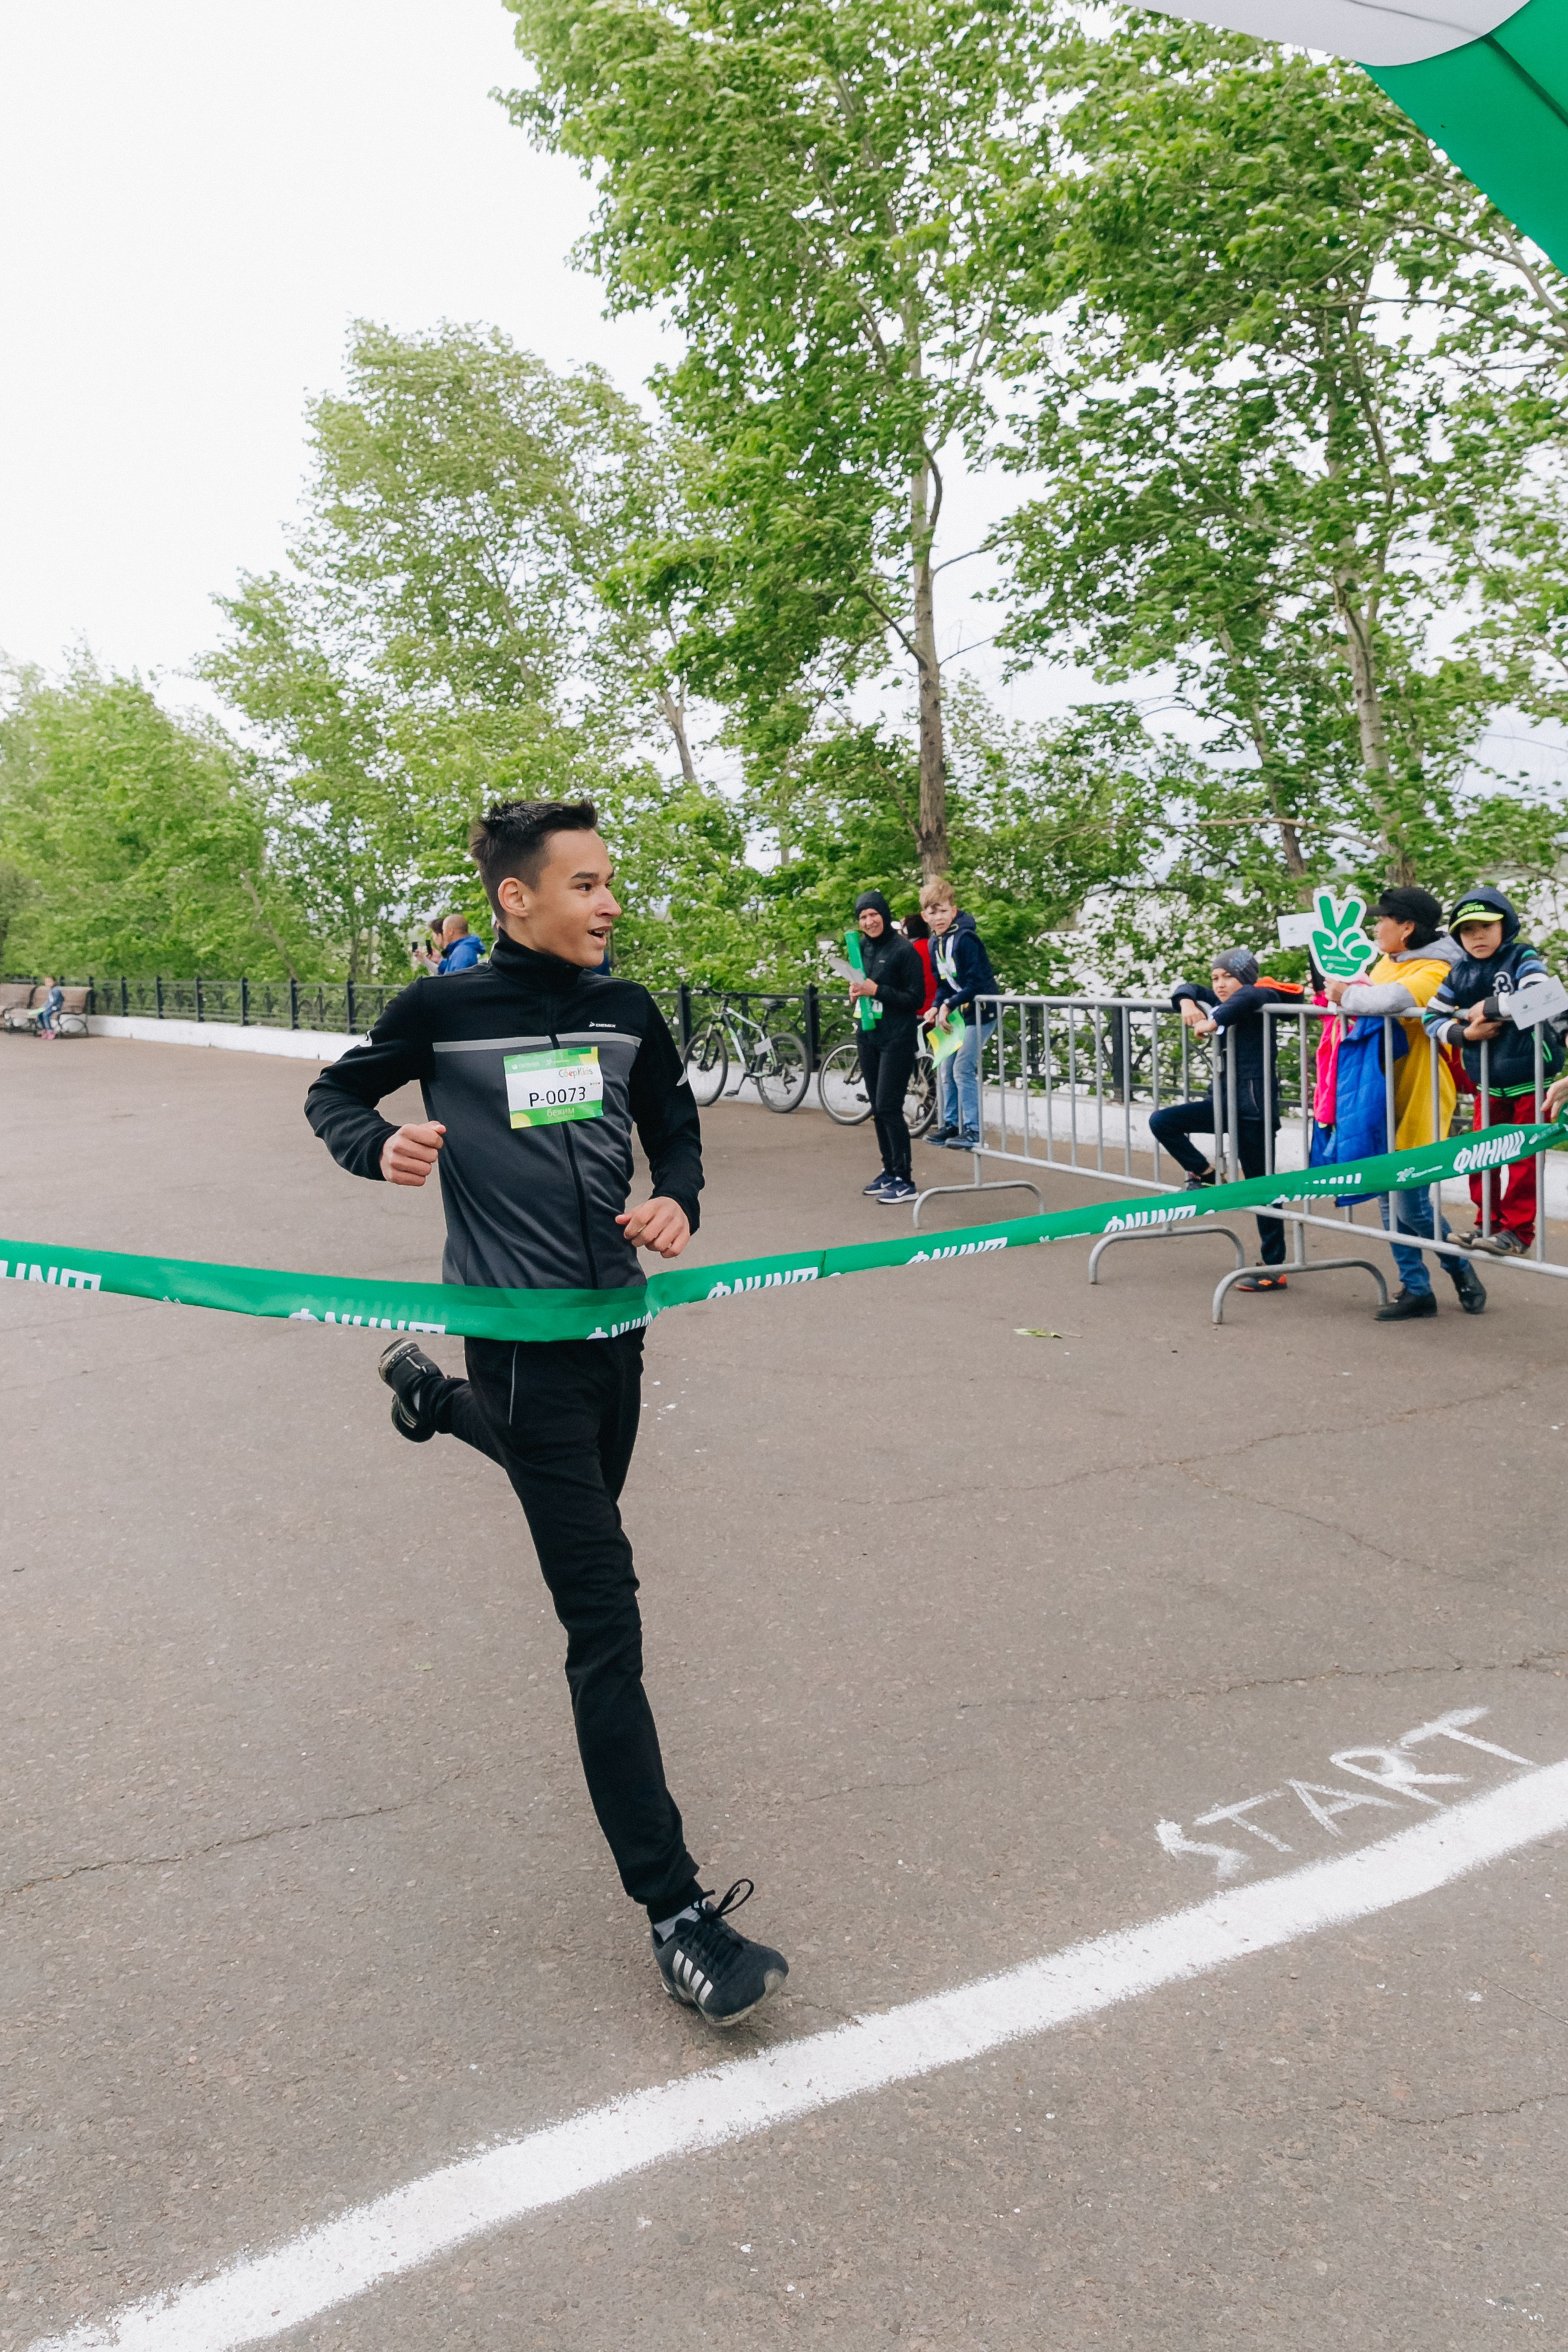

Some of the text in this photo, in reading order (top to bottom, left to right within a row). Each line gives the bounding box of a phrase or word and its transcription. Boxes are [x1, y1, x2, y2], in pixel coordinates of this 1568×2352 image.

[546, 1107, 575, 1117] бежим
[1453, 1130, 1525, 1174] ФИНИШ
[1155, 1706, 1532, 1882] START
